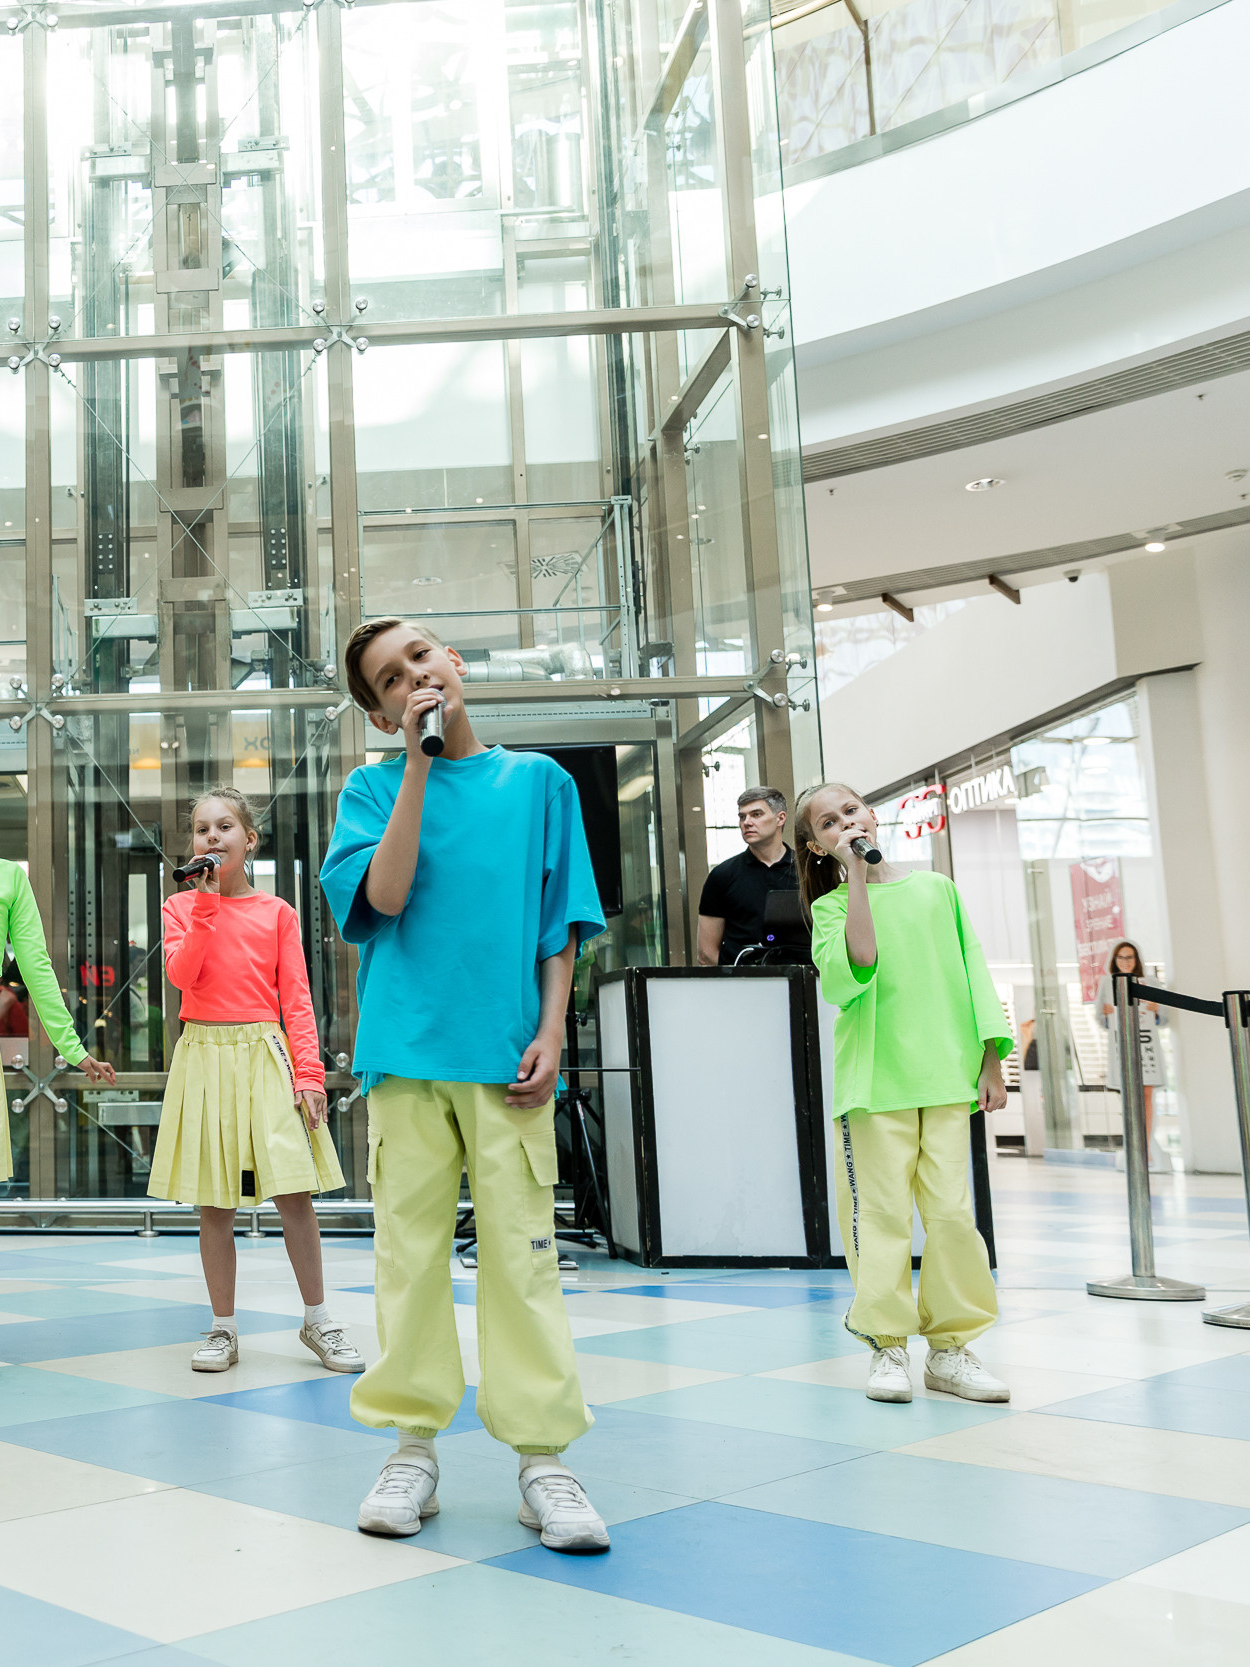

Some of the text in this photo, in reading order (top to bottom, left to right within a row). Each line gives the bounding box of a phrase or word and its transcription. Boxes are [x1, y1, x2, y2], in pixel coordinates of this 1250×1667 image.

[950, 766, 1015, 814] ОПТИКА
[843, 1132, 851, 1151] TIME
[847, 1161, 855, 1187] WANG
[531, 1239, 548, 1250] TIME
